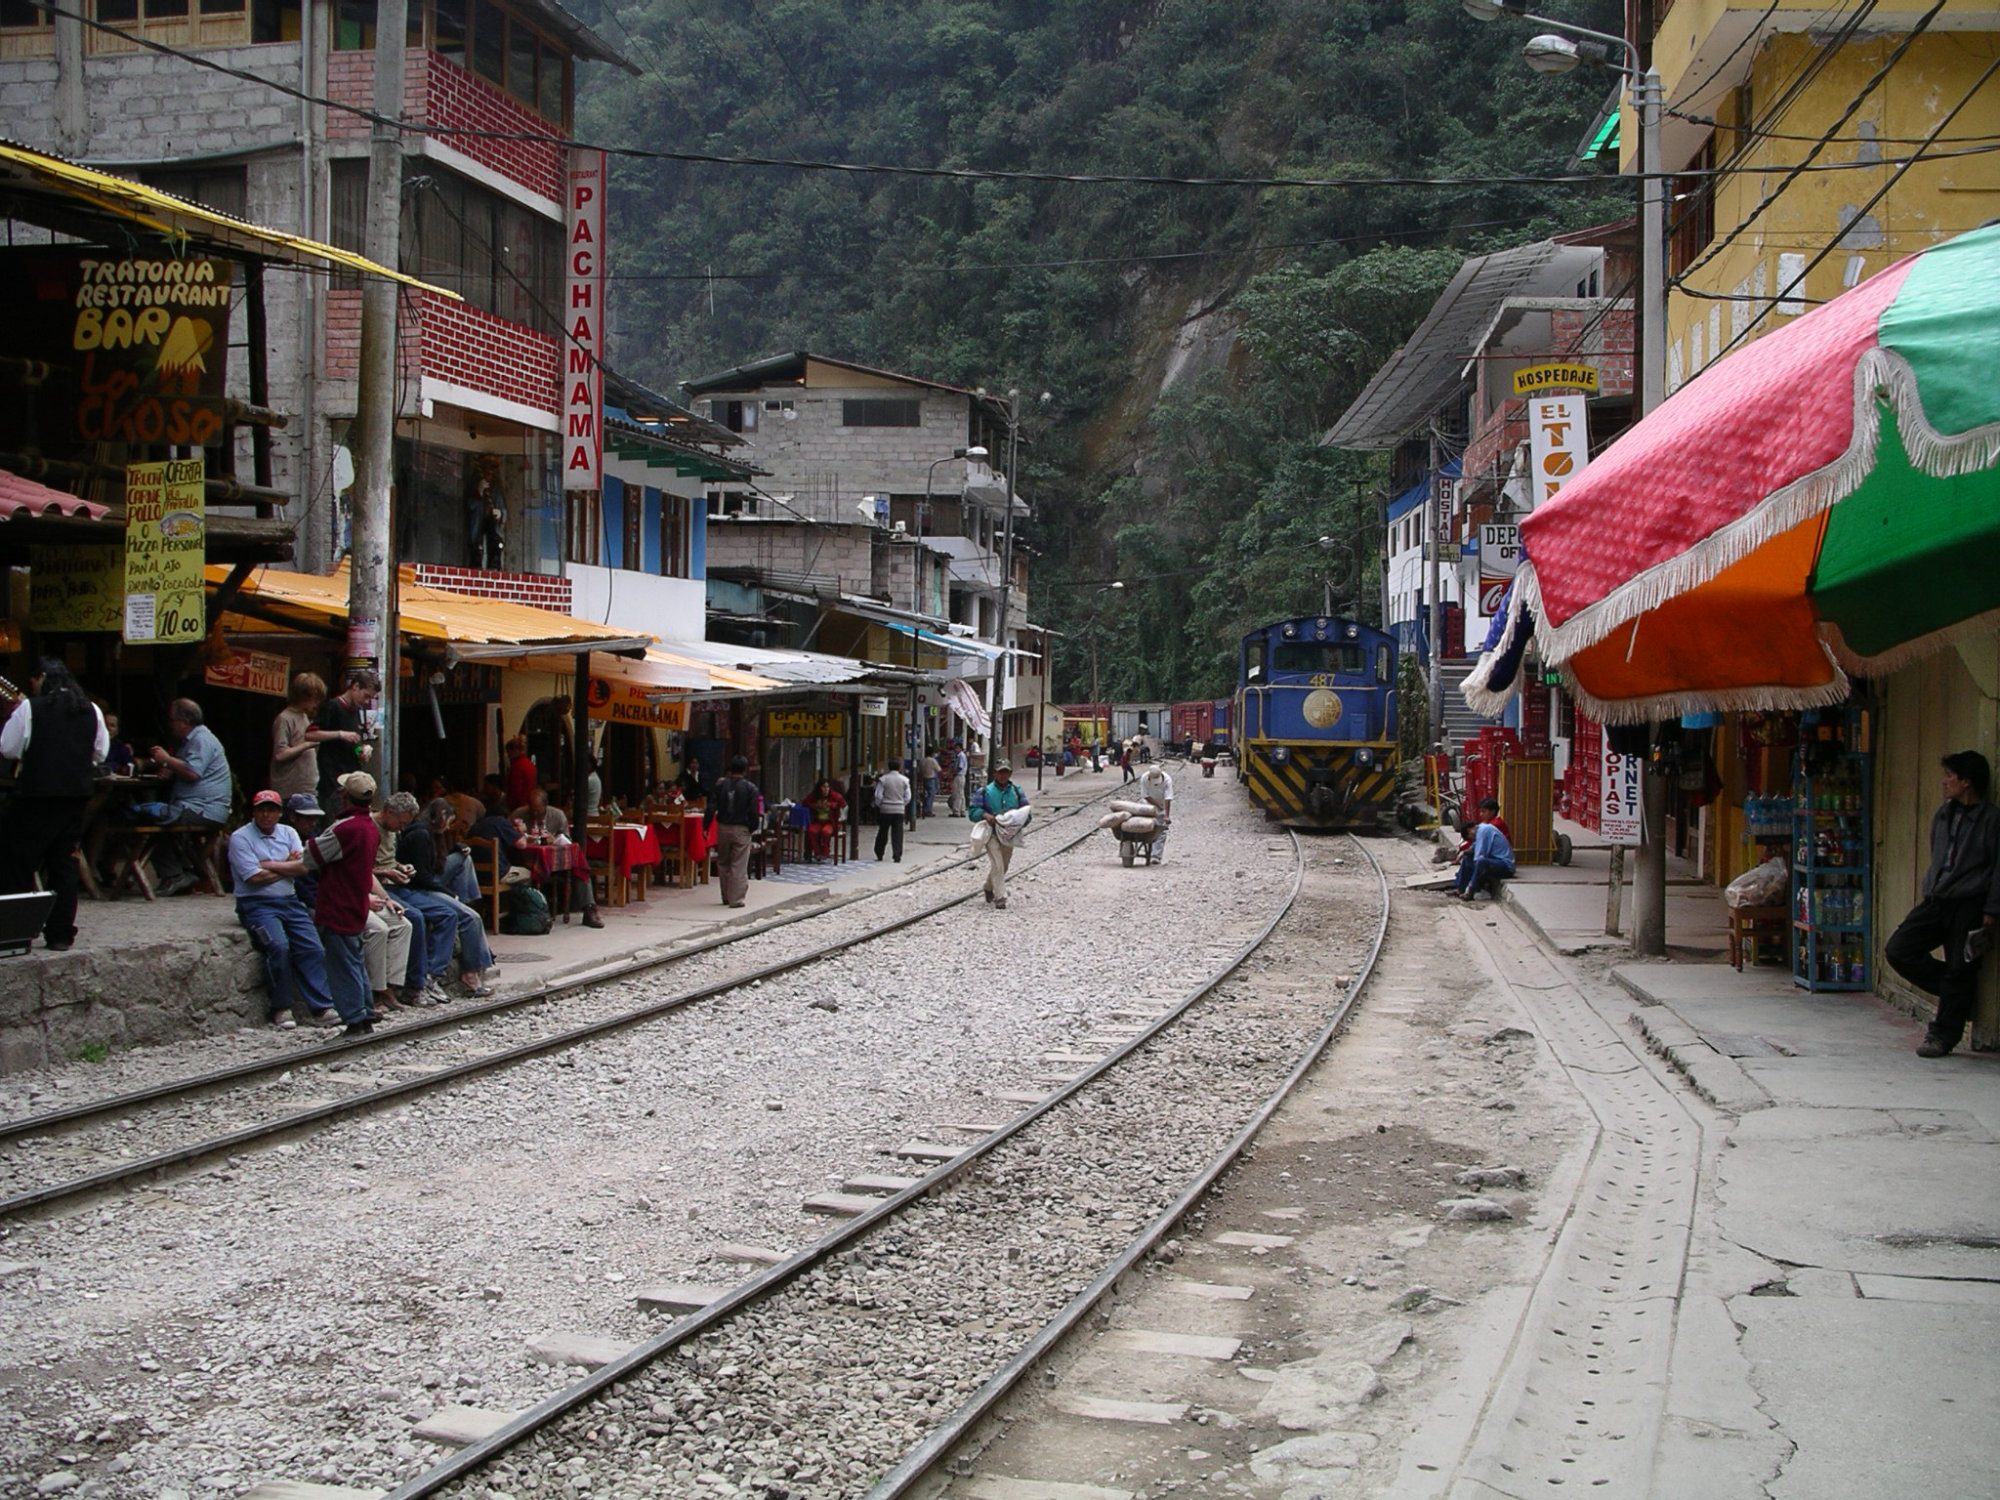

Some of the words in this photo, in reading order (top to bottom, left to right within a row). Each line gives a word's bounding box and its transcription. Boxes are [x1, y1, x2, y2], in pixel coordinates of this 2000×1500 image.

[80, 260, 214, 284] TRATORIA
[76, 282, 230, 308] RESTAURANT
[74, 307, 170, 350] BAR
[569, 187, 593, 470] PACHAMAMA
[1518, 368, 1594, 388] HOSPEDAJE
[1541, 404, 1571, 419] EL
[166, 462, 202, 483] OFERTA
[126, 504, 162, 528] POLLO
[1441, 480, 1451, 542] HOSTAL
[127, 536, 158, 554] PIZZA
[1500, 546, 1519, 559] OF
[160, 609, 199, 637] 10.00
[1309, 673, 1336, 687] 487
[612, 702, 679, 725] PACHAMAMA
